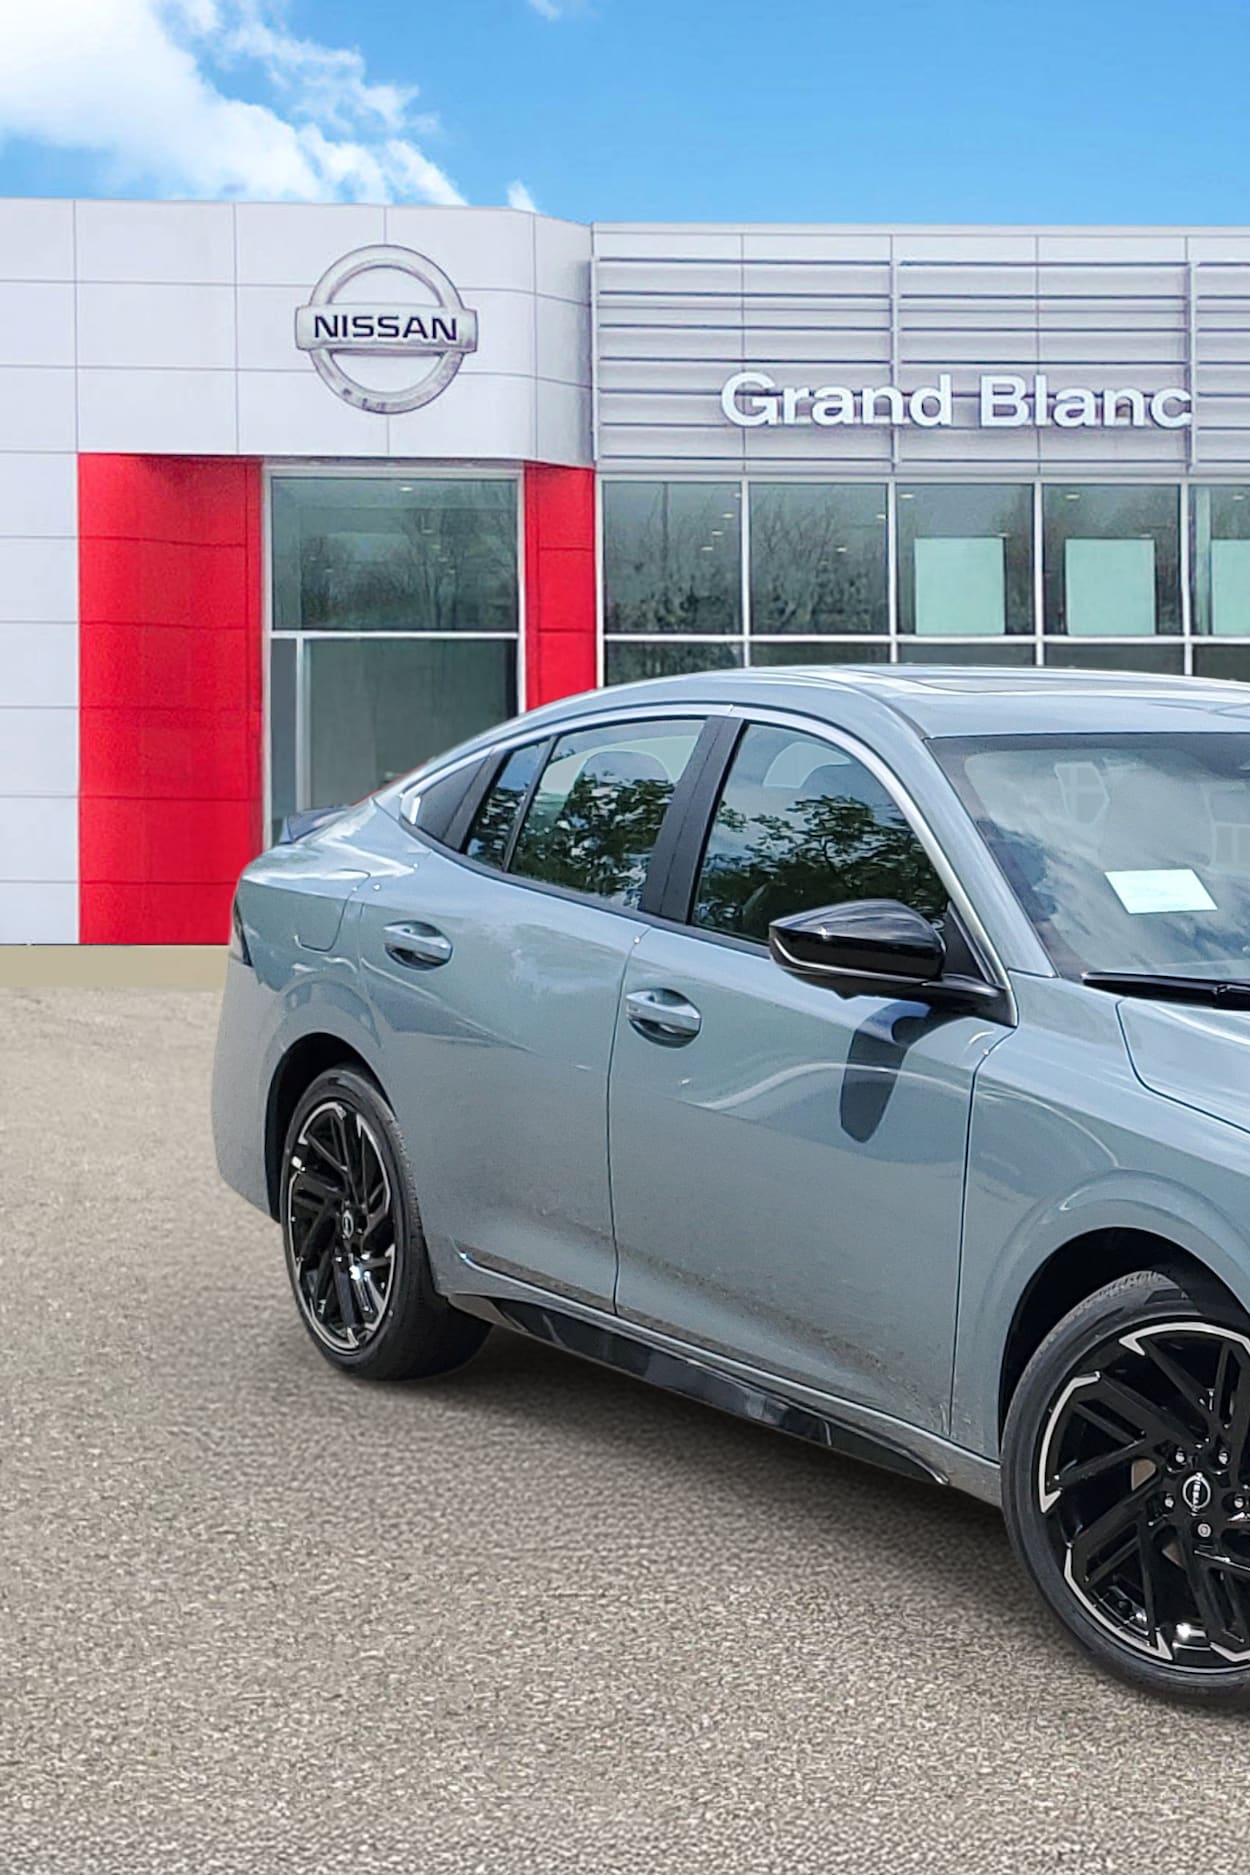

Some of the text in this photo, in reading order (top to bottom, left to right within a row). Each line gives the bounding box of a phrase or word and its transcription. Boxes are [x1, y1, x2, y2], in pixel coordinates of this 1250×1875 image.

[314, 315, 457, 341] NISSAN
[720, 371, 1193, 428] Grand Blanc
